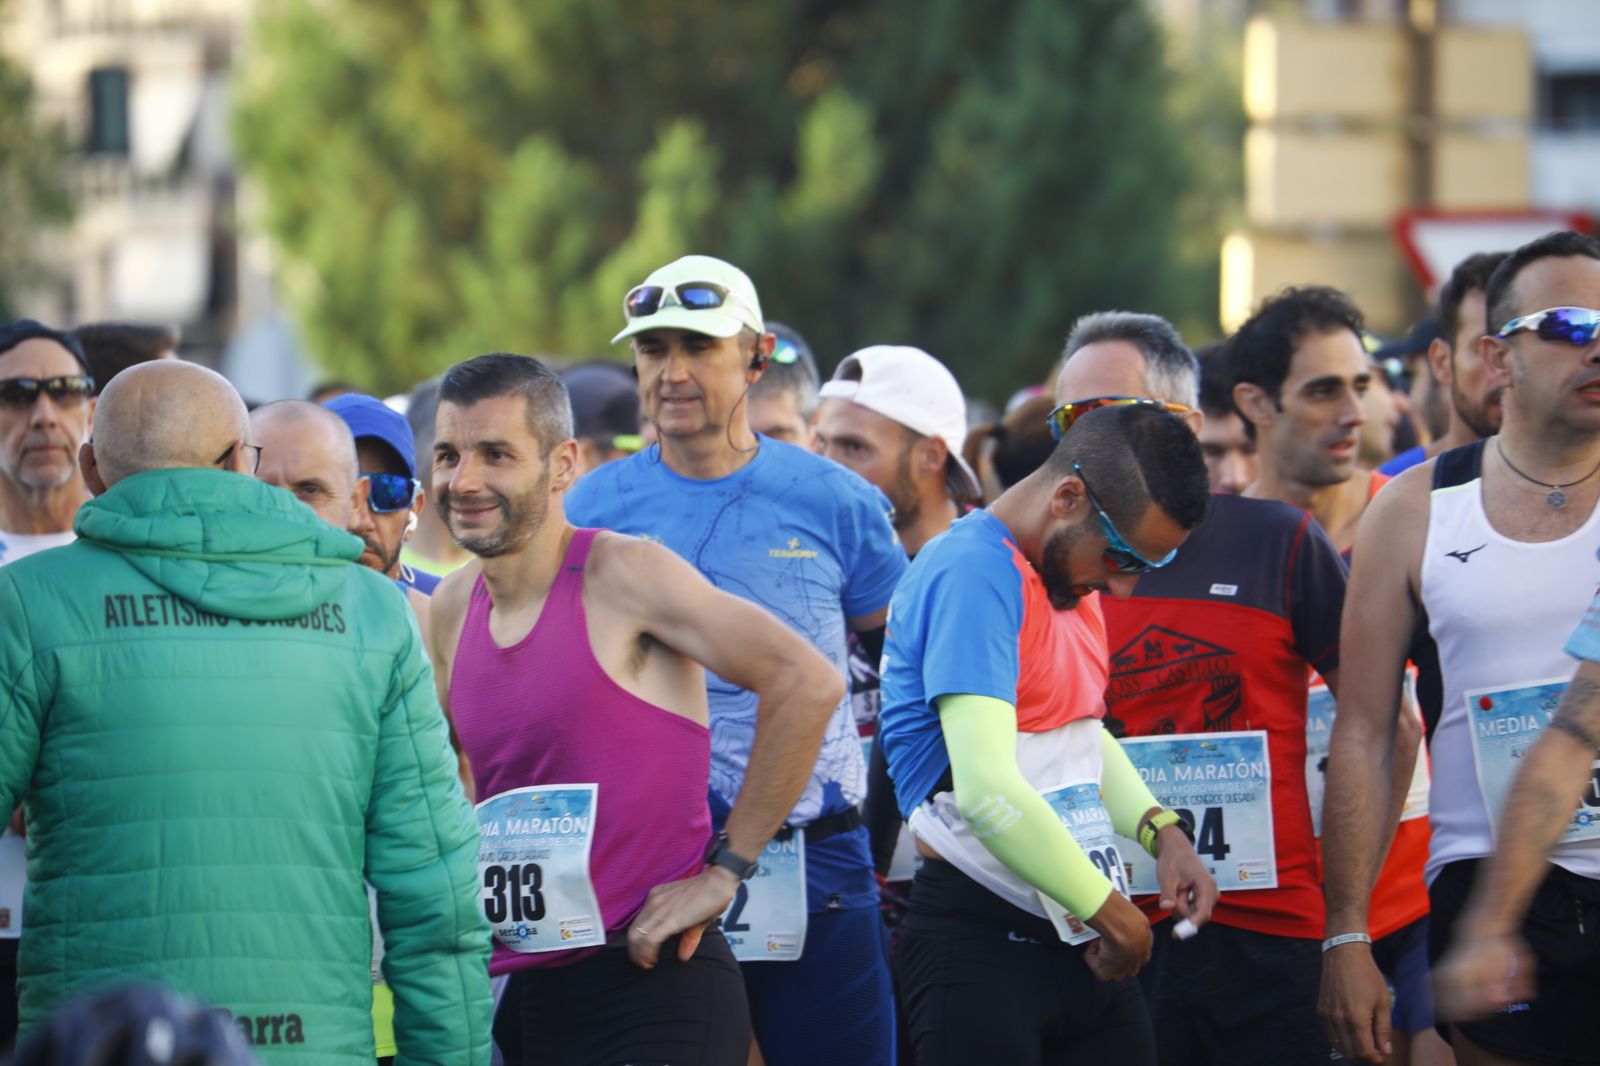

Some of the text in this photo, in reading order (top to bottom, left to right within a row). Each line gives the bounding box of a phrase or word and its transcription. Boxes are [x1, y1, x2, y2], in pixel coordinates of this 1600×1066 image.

[1478, 715, 1540, 737] MEDIA
[1137, 758, 1264, 784] DIA MARATÓN
[505, 813, 588, 836] MARATÓN
[484, 862, 546, 923] 313
[717, 881, 751, 932] 2
[214, 1008, 305, 1046] arra
